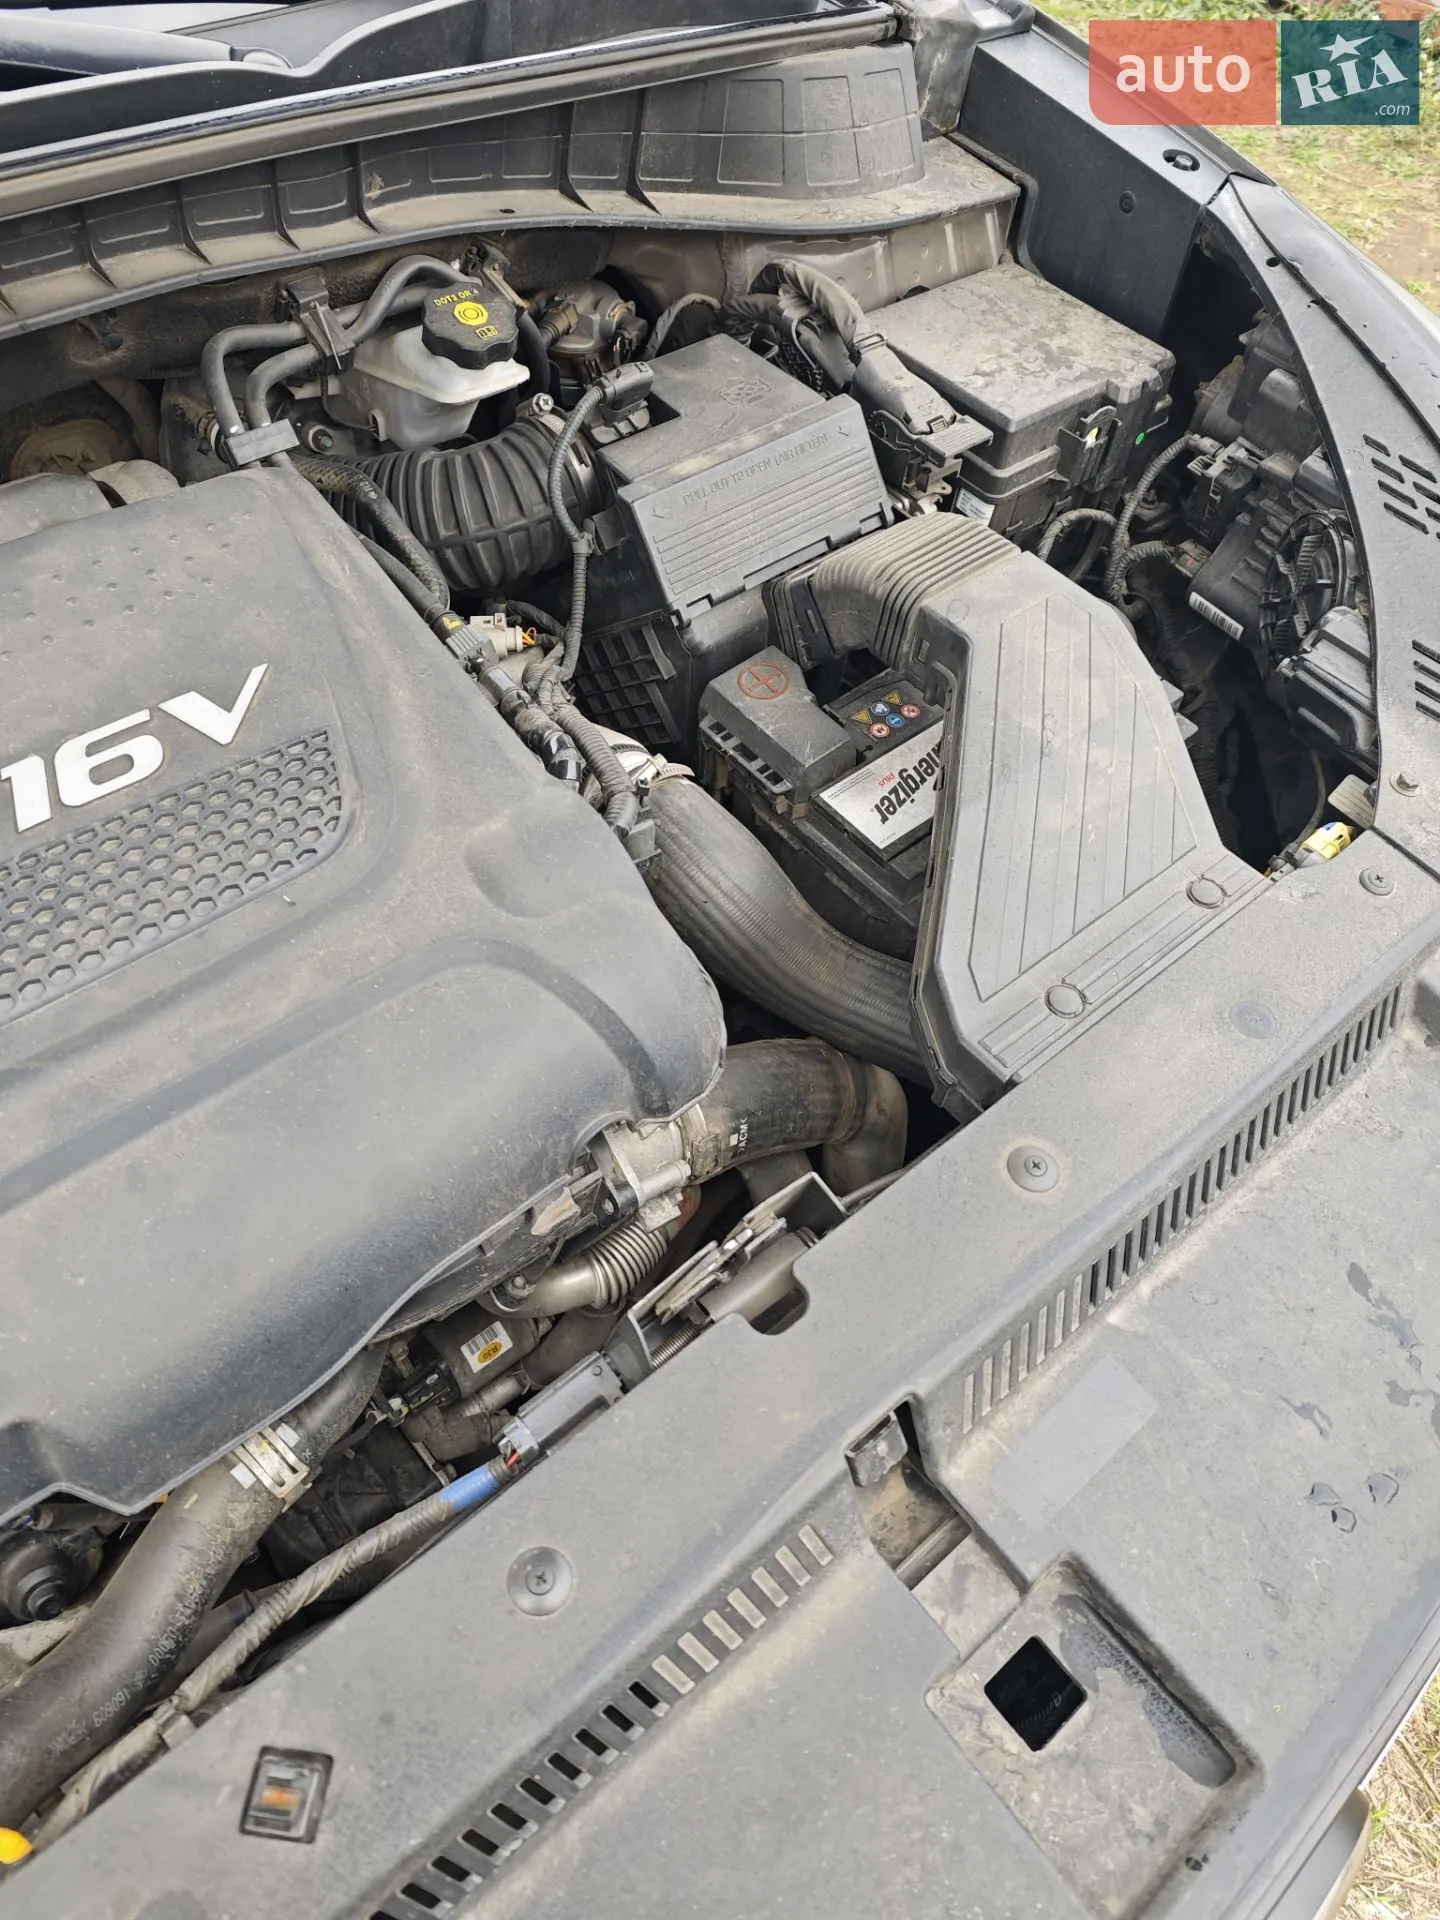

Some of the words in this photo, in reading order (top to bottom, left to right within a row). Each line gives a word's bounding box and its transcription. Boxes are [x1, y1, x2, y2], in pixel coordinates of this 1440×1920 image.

[433, 295, 458, 306] DOT3
[710, 478, 730, 494] OUT
[745, 459, 772, 478] OPEN
[0, 663, 269, 832] 16V
[873, 740, 942, 825] nergizer
[482, 1345, 499, 1360] R30
